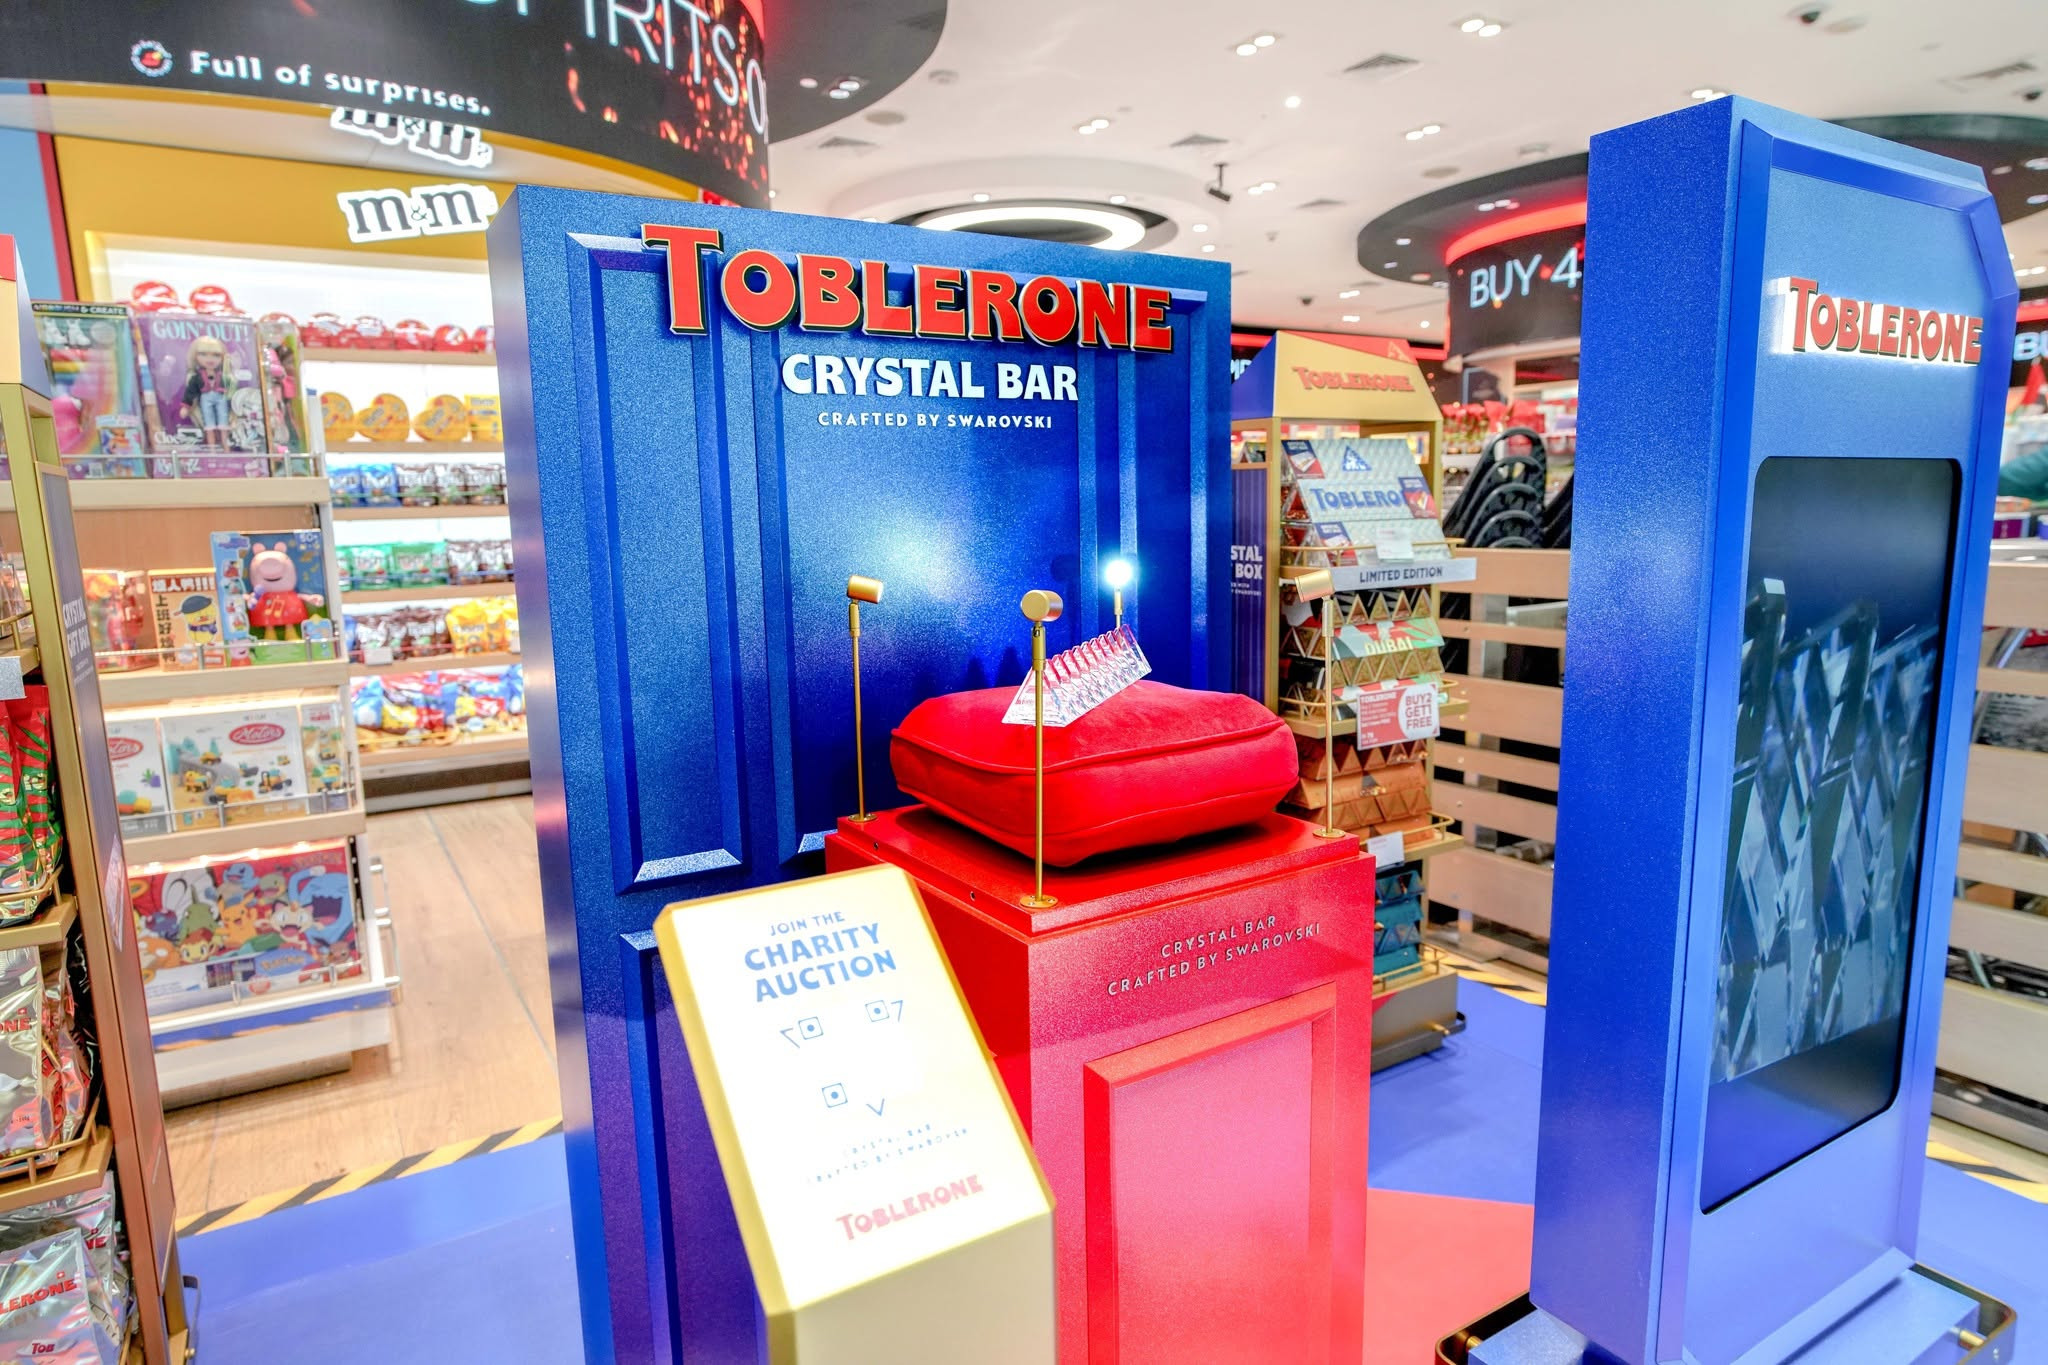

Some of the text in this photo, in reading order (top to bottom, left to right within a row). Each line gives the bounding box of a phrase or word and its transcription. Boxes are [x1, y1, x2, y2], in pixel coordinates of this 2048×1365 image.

[190, 50, 492, 117] Full of surprises.
[641, 223, 1176, 353] TOBLERONE
[1470, 247, 1582, 309] BUY 4
[206, 321, 250, 342] OUT!
[1790, 276, 1984, 365] TOBLERONE
[782, 354, 1079, 401] CRYSTAL BAR
[1292, 366, 1416, 393] TOBLERONE
[818, 411, 1052, 429] CRAFTED BY SWAROVSKI
[1235, 562, 1263, 580] BOX
[1359, 566, 1443, 584] LIMITED EDITION
[1364, 636, 1414, 656] DUBAI
[1406, 715, 1432, 730] FREE
[770, 911, 846, 937] JOIN THE
[1161, 915, 1277, 958] CRYSTAL BAR
[744, 923, 880, 971] CHARITY
[1107, 923, 1321, 996] CRAFTED BY SWAROVSKI
[756, 950, 897, 1003] AUCTION
[836, 1174, 984, 1240] TOBLERONE
